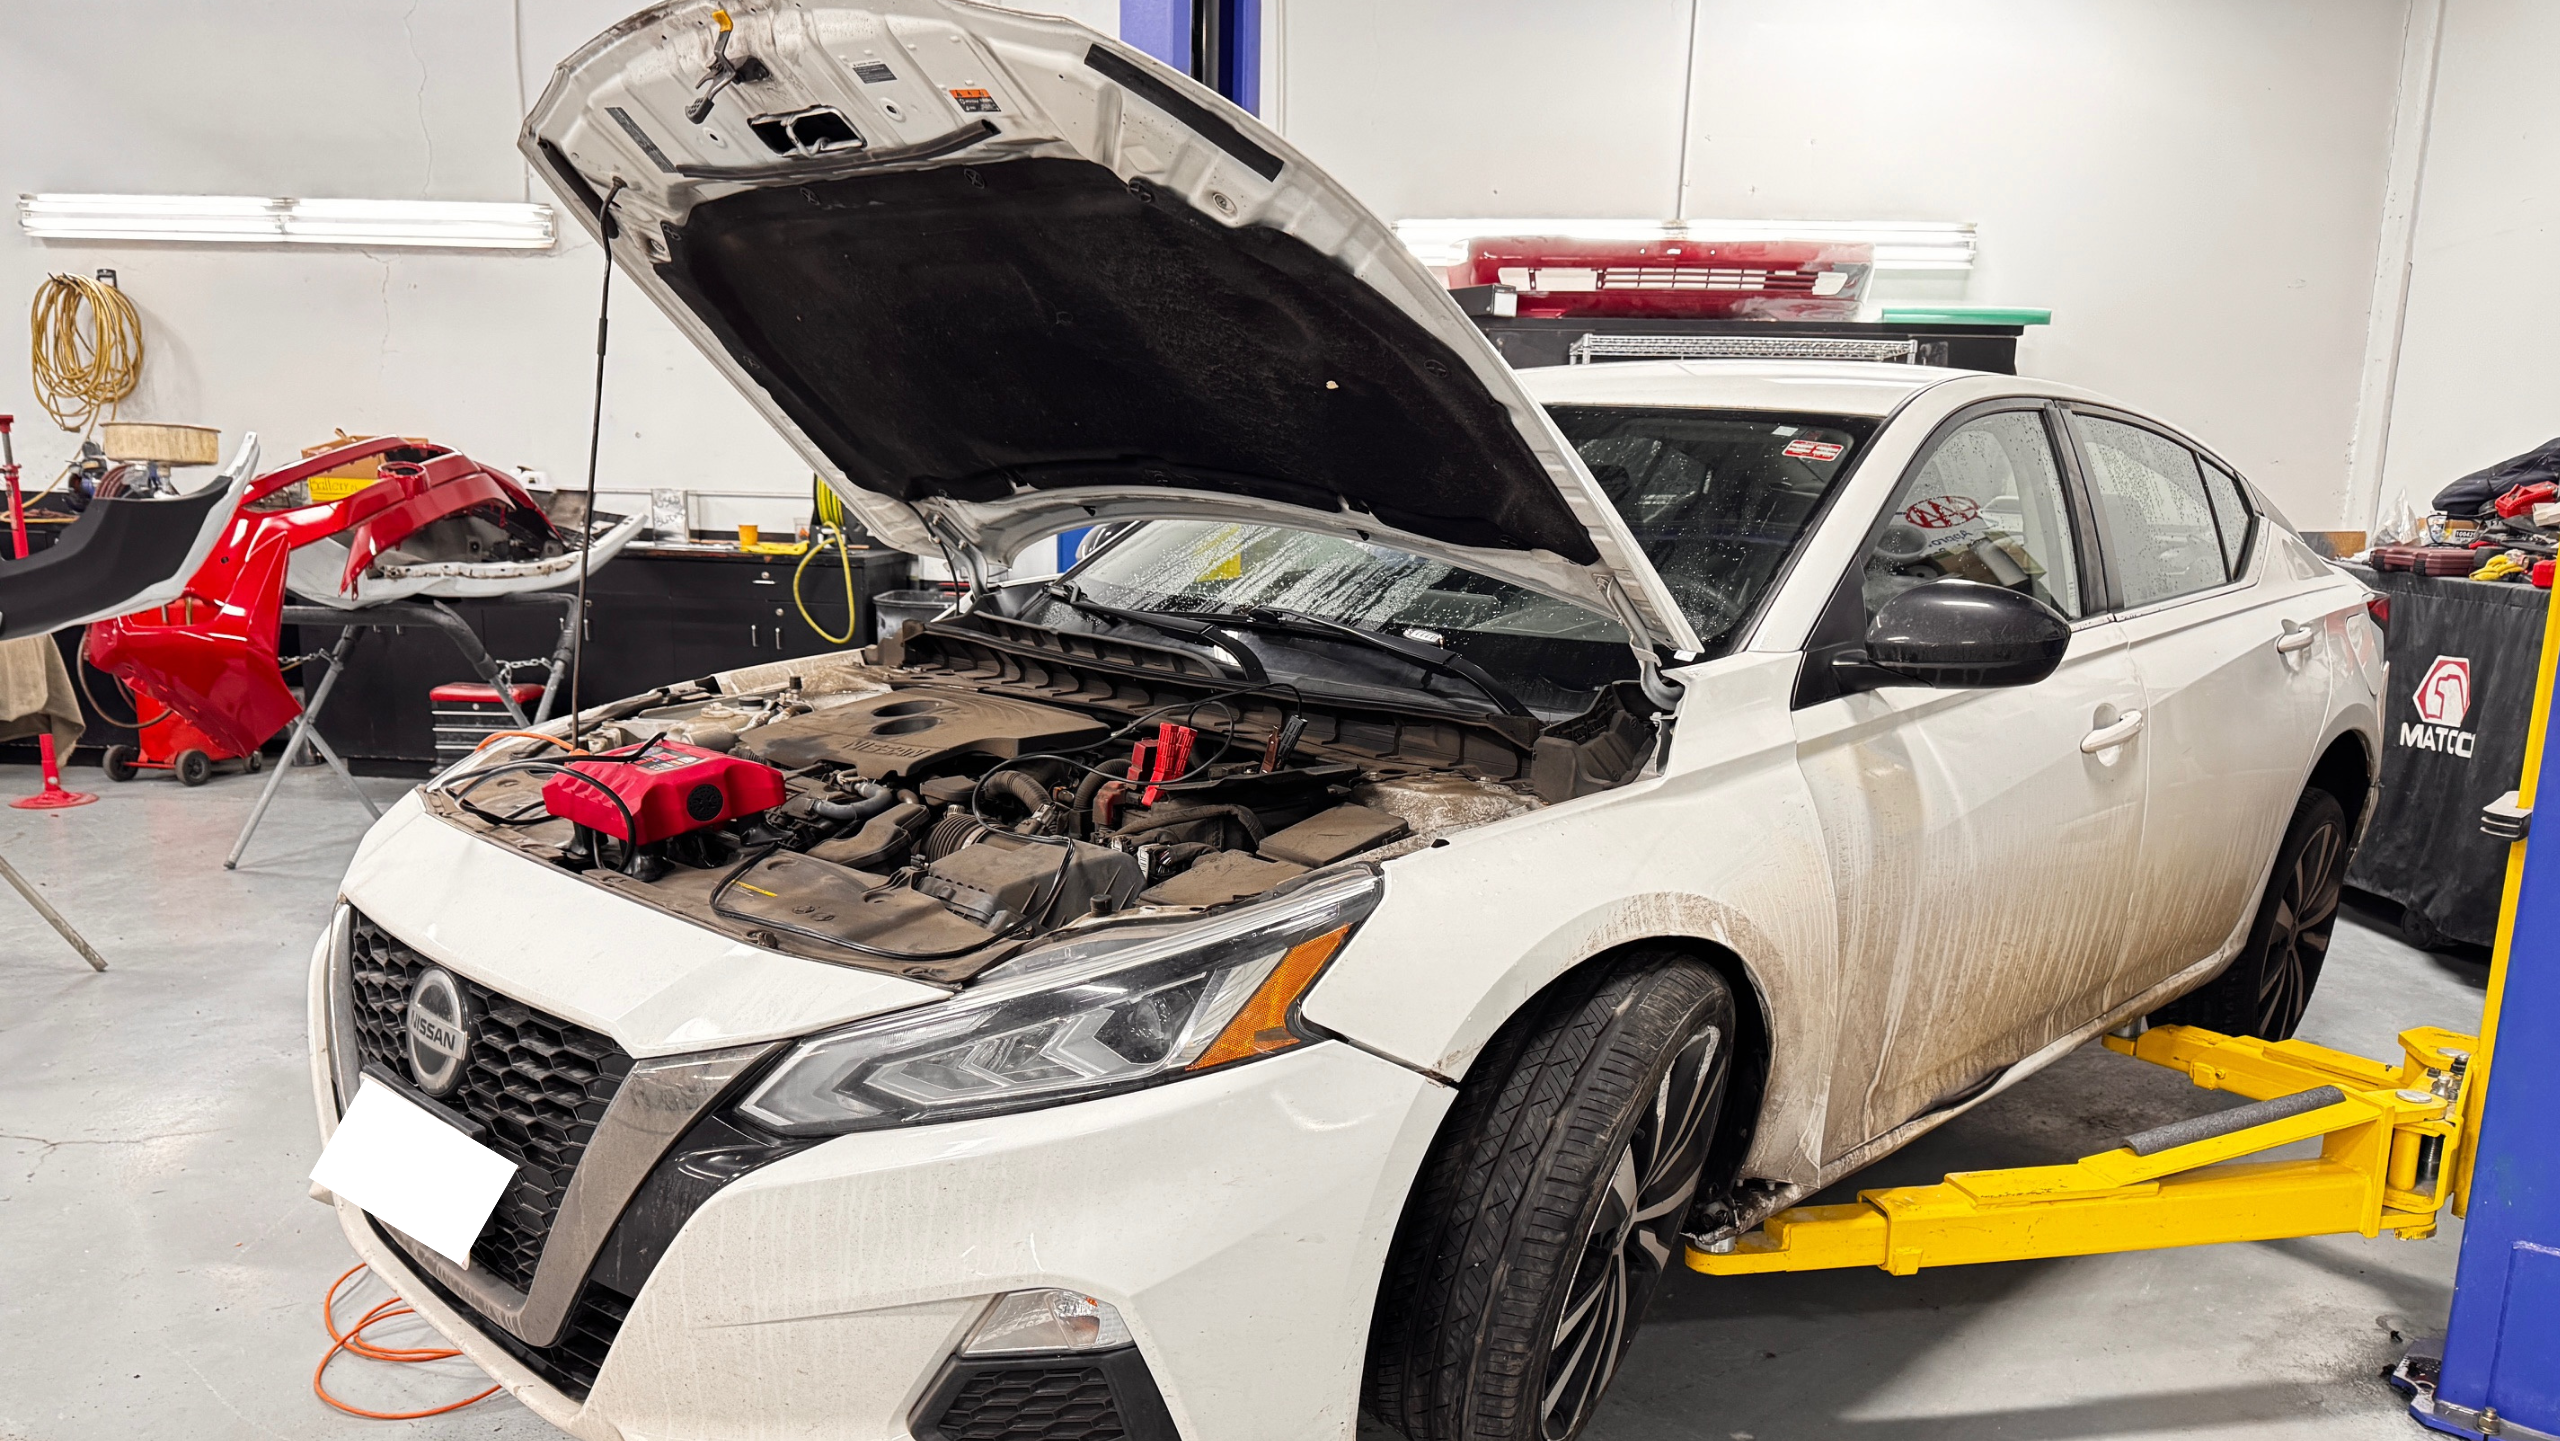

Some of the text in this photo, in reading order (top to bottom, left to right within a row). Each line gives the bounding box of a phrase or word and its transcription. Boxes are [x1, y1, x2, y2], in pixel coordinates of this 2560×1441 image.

[842, 740, 931, 758] NISSAN
[2399, 722, 2476, 758] MATCO
[411, 1009, 456, 1051] NISSAN
